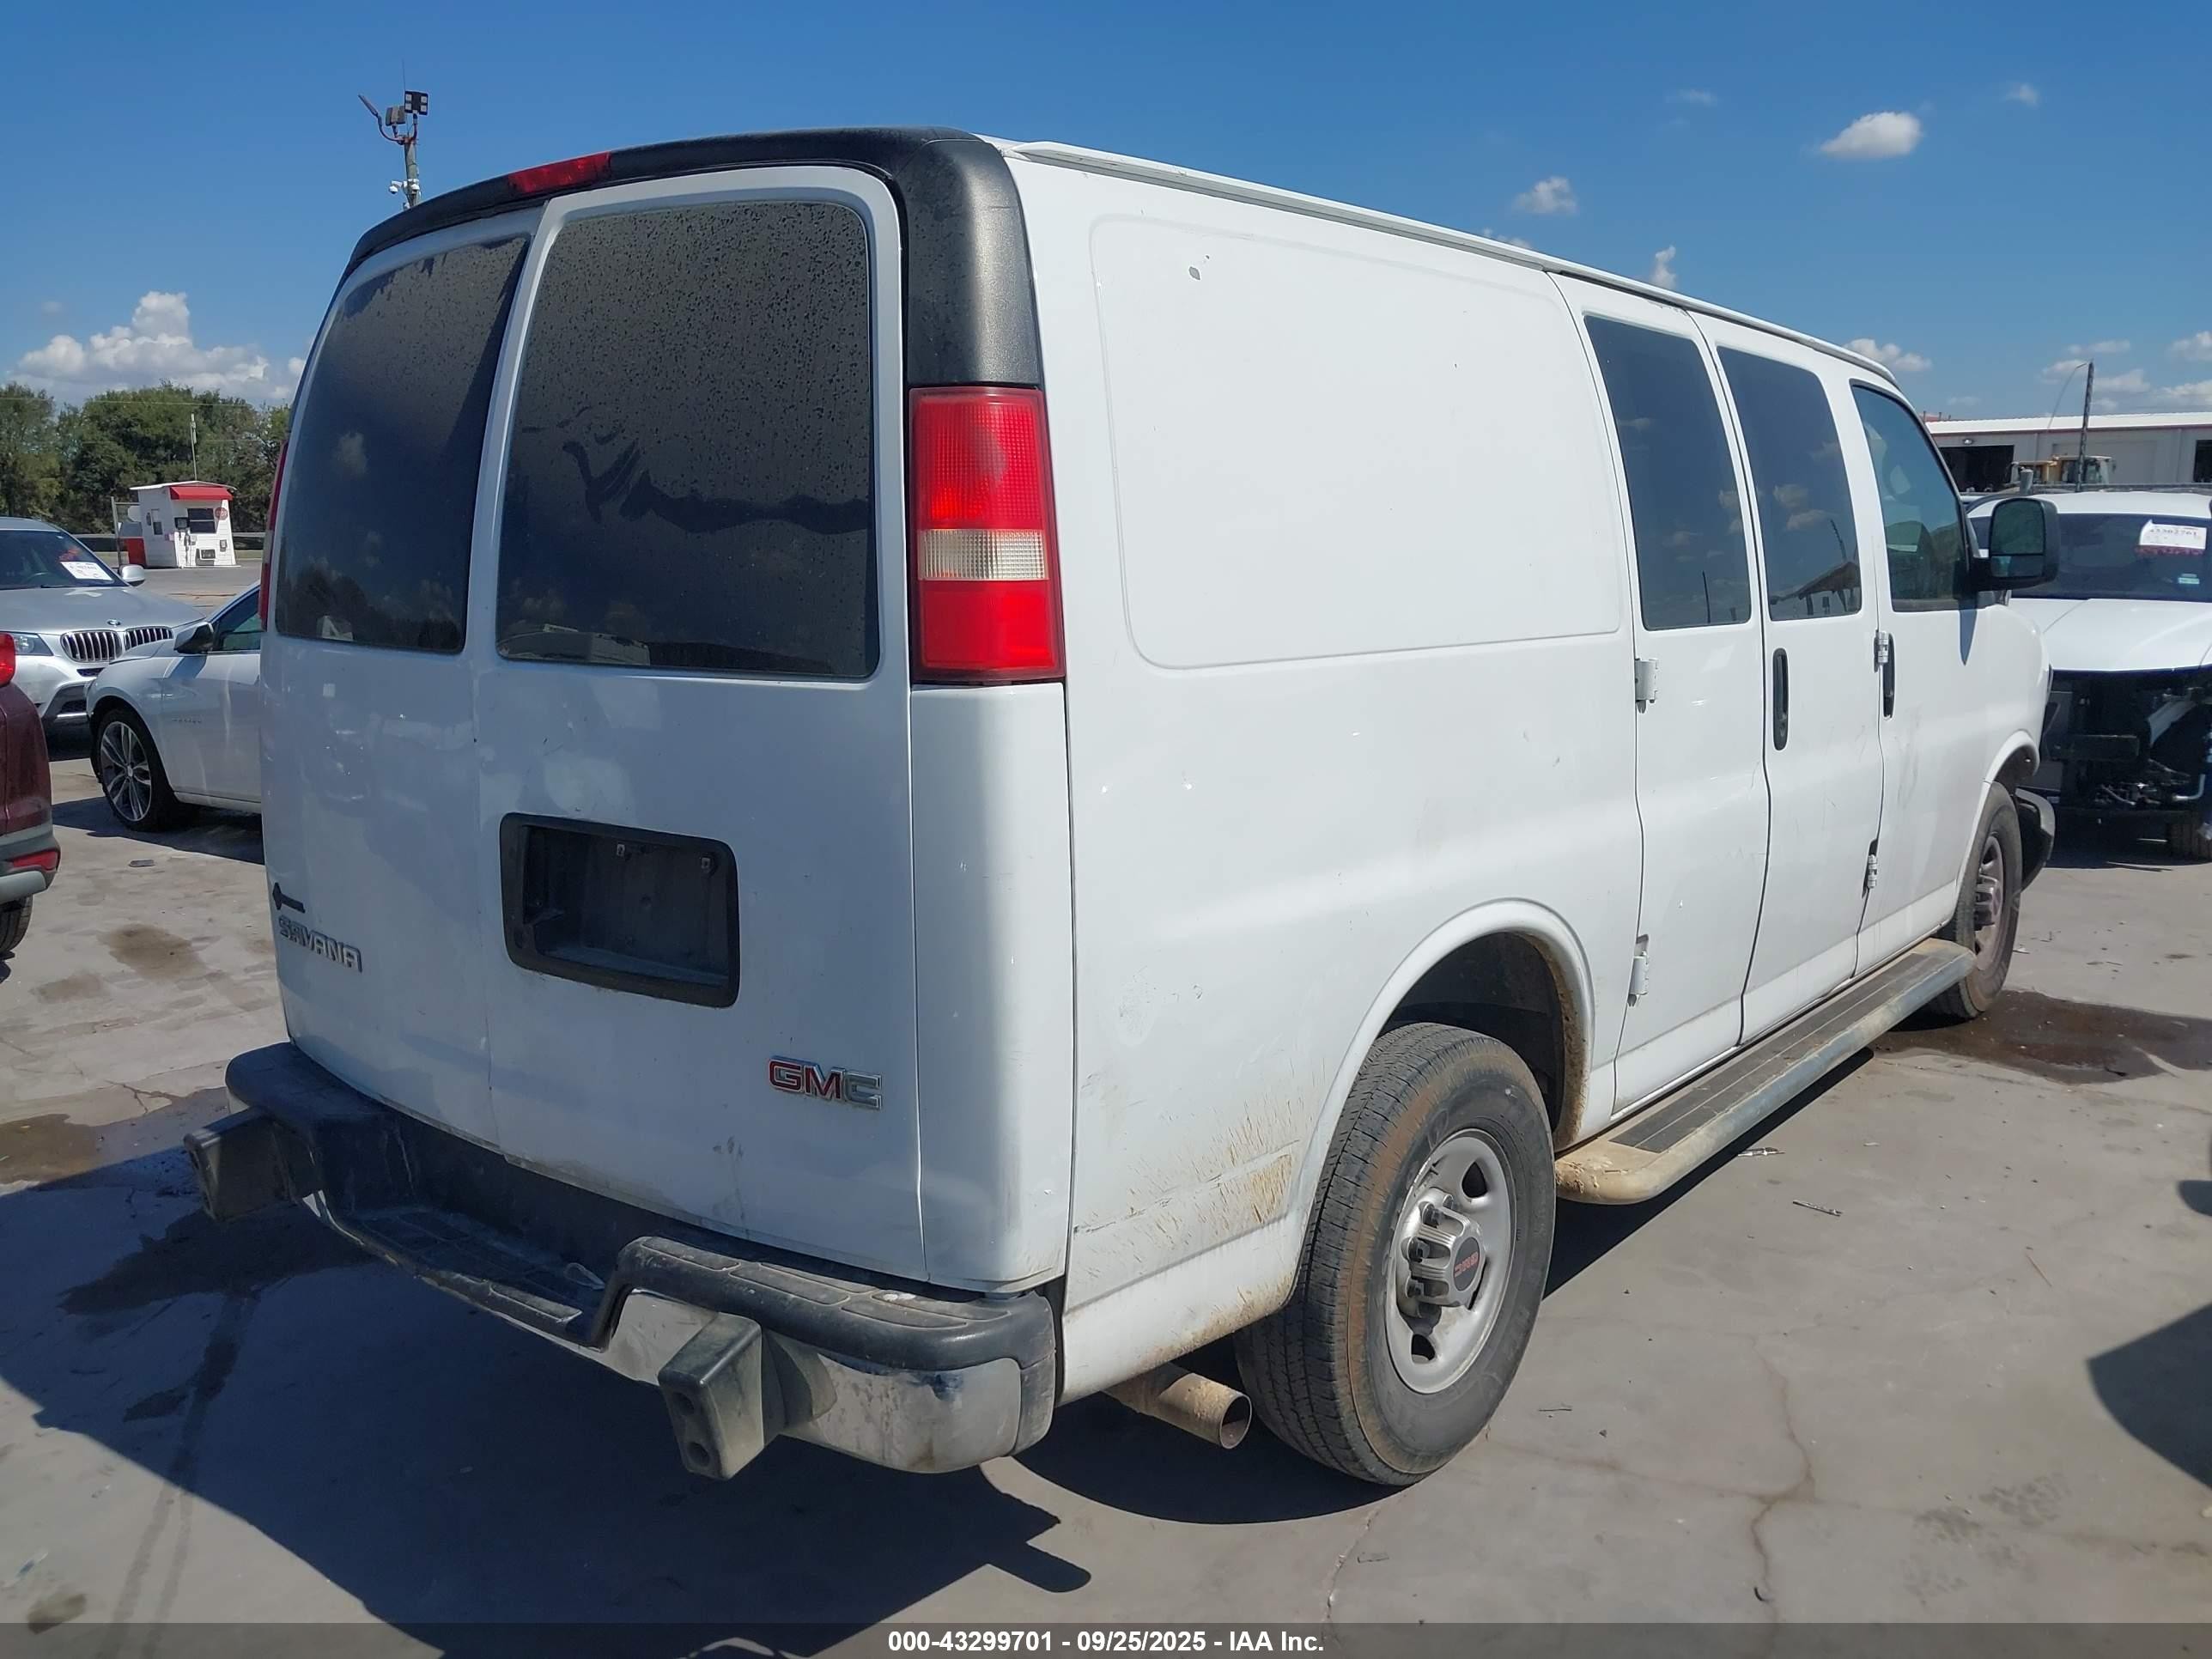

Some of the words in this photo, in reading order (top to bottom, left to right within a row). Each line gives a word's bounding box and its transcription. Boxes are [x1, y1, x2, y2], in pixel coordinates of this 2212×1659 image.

[278, 915, 363, 974] SAVANA
[769, 1055, 883, 1110] GMC
[1454, 1251, 1480, 1278] GMC
